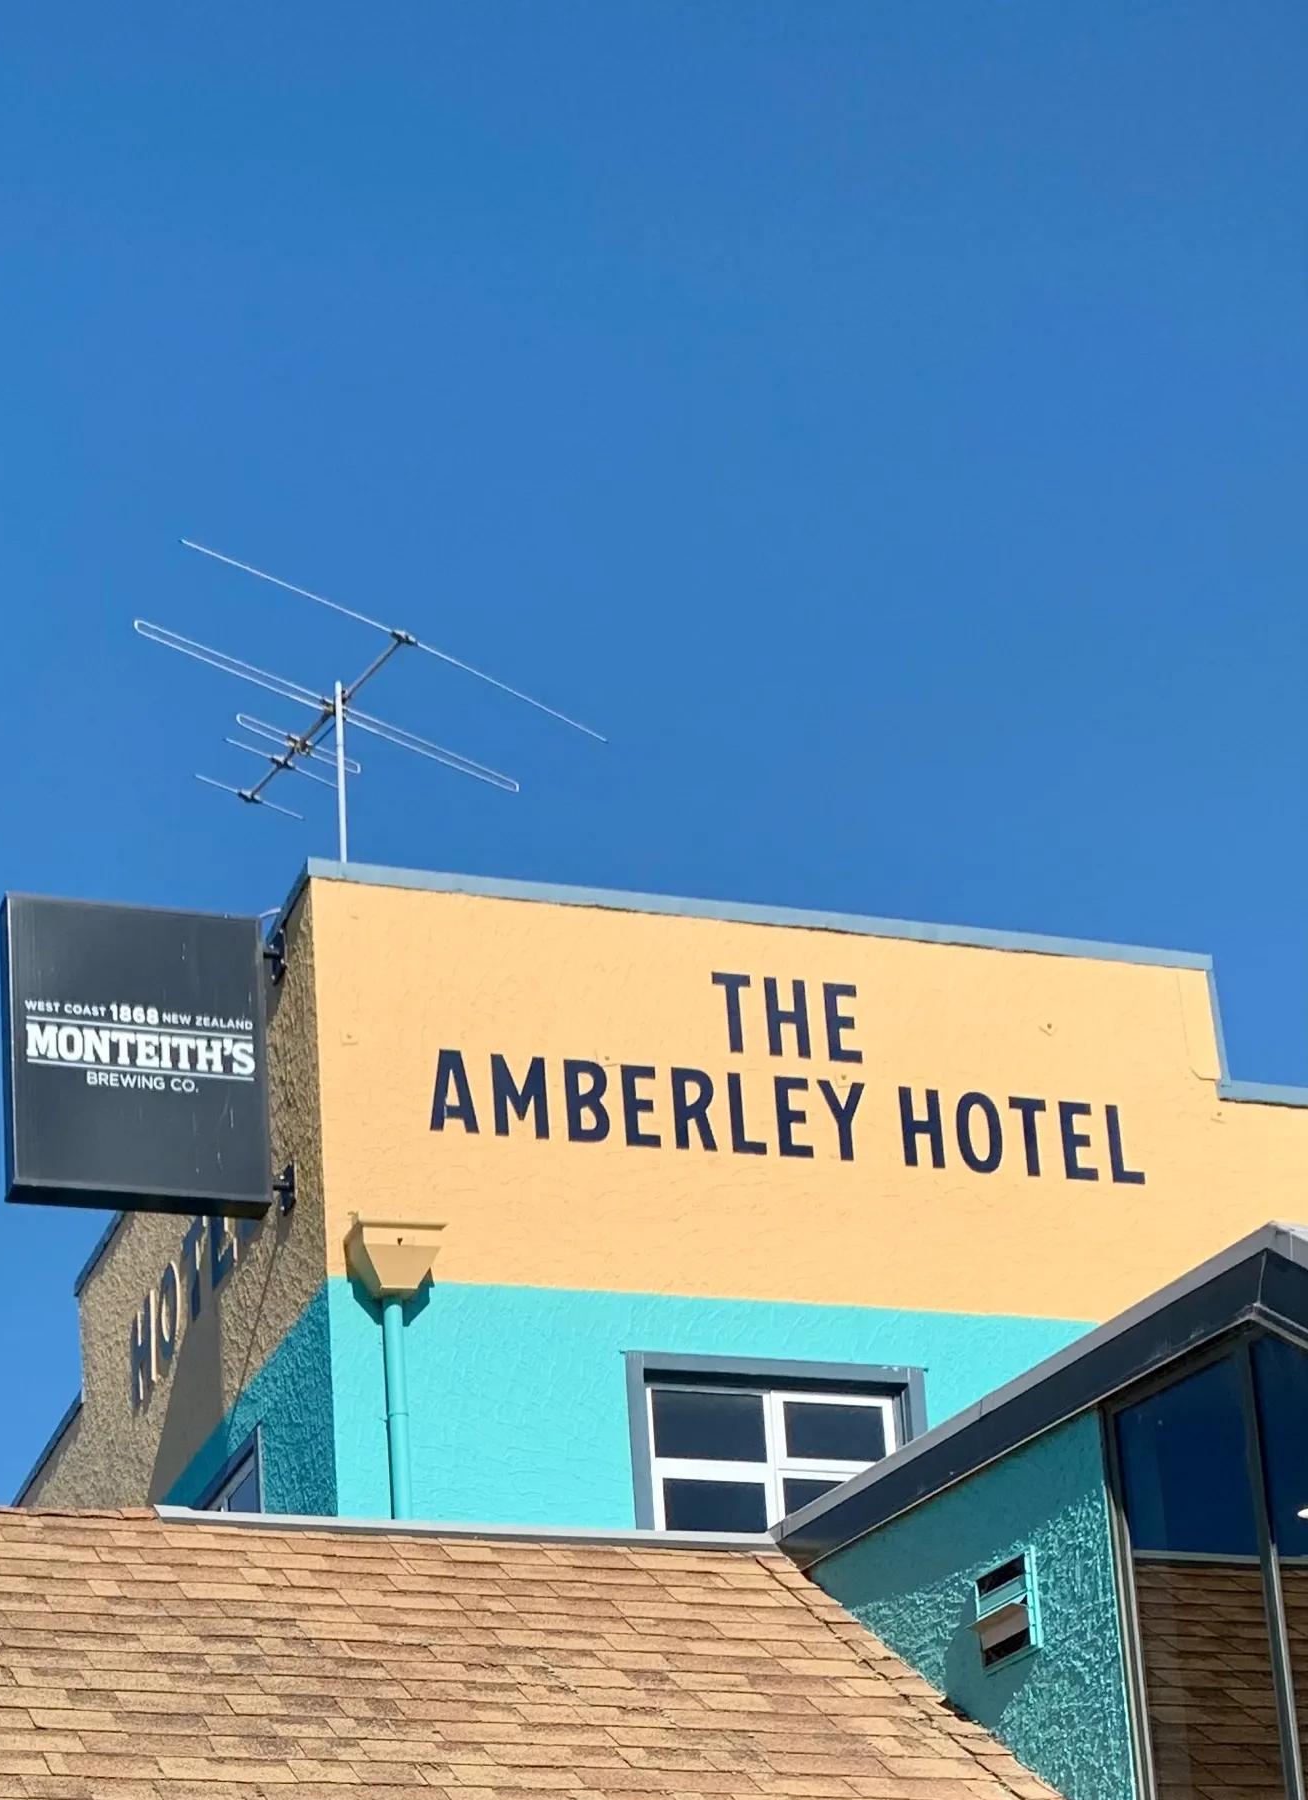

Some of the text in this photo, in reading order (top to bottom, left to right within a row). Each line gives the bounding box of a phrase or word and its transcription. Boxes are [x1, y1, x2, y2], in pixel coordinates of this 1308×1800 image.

[25, 999, 254, 1031] WEST COAST 1868 NEW ZEALAND
[711, 971, 864, 1064] THE
[24, 1023, 256, 1076] MONTEITH'S
[86, 1071, 199, 1093] BREWING CO.
[429, 1048, 1147, 1185] AMBERLEY HOTEL
